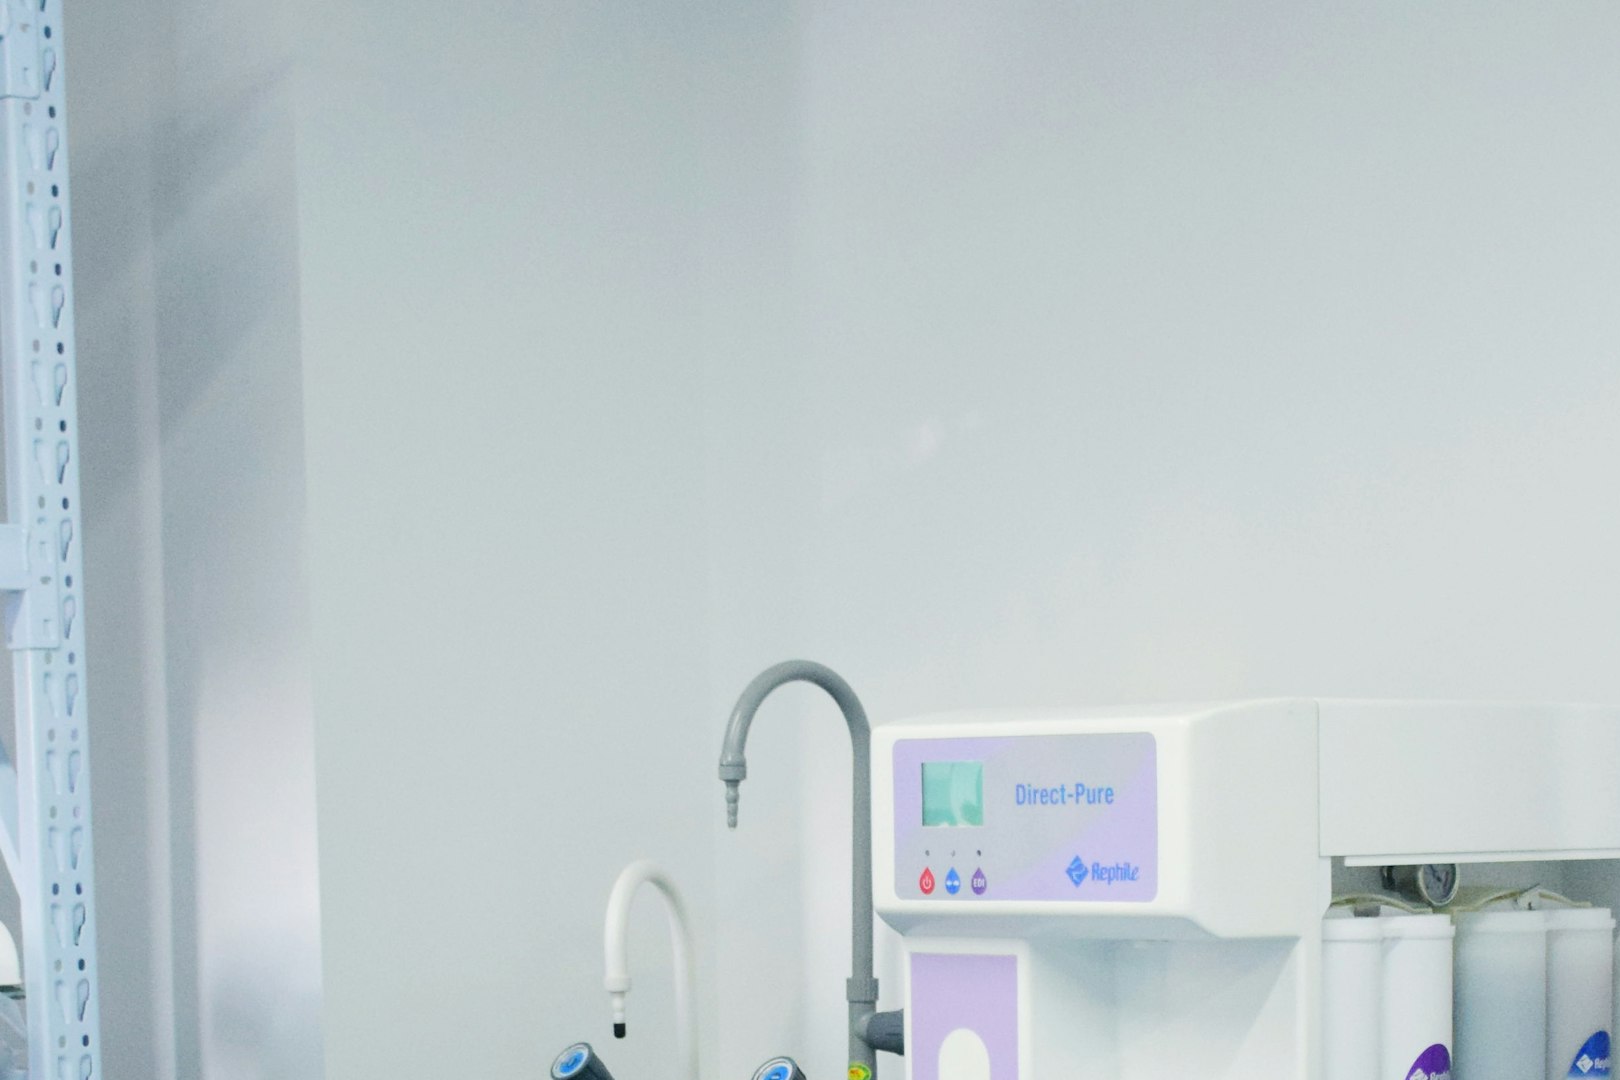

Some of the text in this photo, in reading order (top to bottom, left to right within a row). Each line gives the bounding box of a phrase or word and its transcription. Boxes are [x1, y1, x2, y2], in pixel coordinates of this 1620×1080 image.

[1015, 784, 1114, 806] Direct-Pure
[973, 878, 986, 888] EDI
[1090, 861, 1140, 886] Rephile
